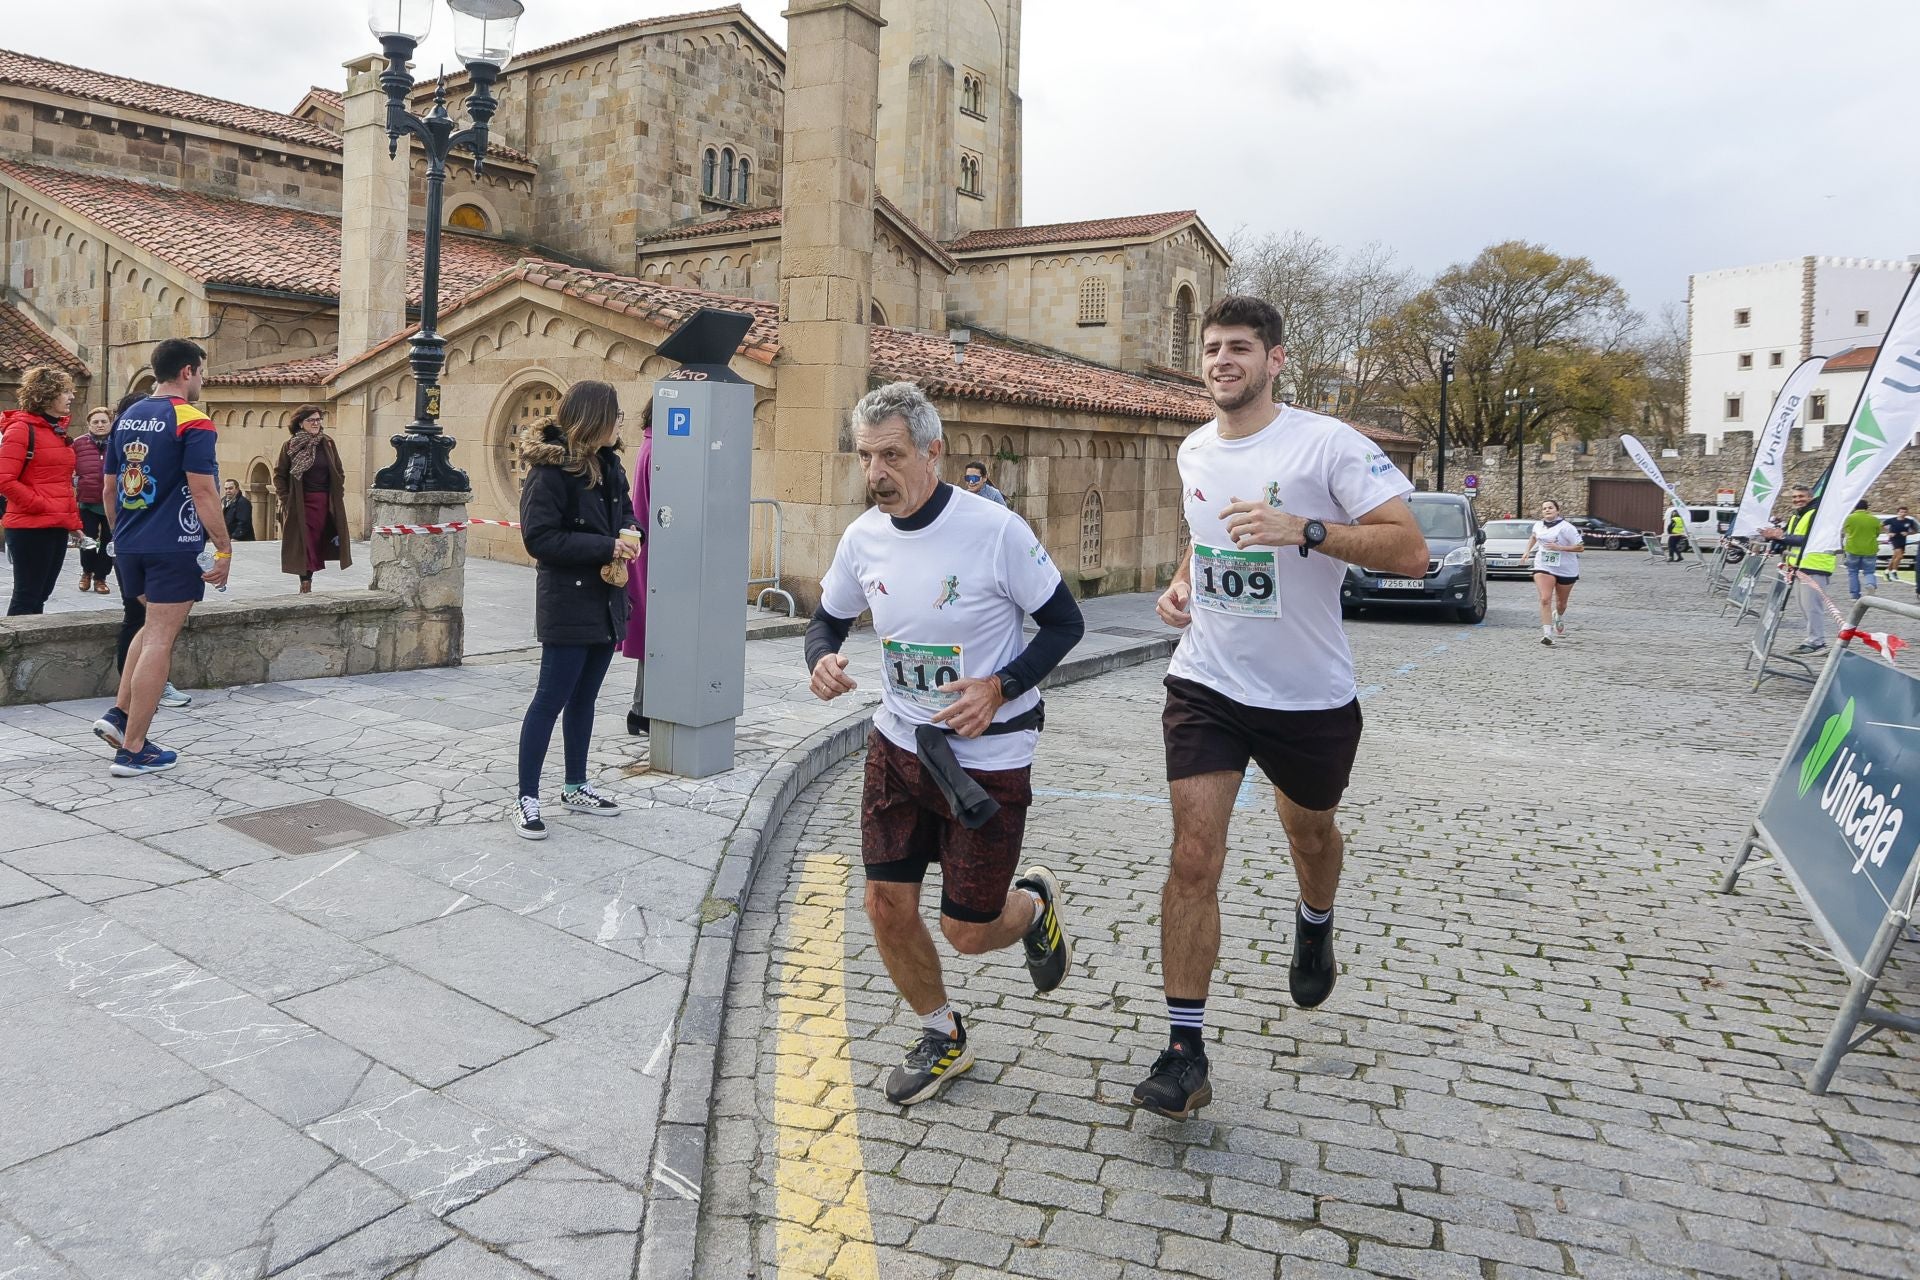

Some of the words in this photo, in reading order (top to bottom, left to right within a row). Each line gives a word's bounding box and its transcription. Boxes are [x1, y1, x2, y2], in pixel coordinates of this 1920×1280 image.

[117, 417, 166, 432] ESCAÑO
[674, 413, 686, 431] P
[1204, 566, 1274, 600] 109
[1383, 580, 1404, 588] 7256
[893, 660, 959, 692] 110
[1821, 747, 1904, 875] Unicaja
